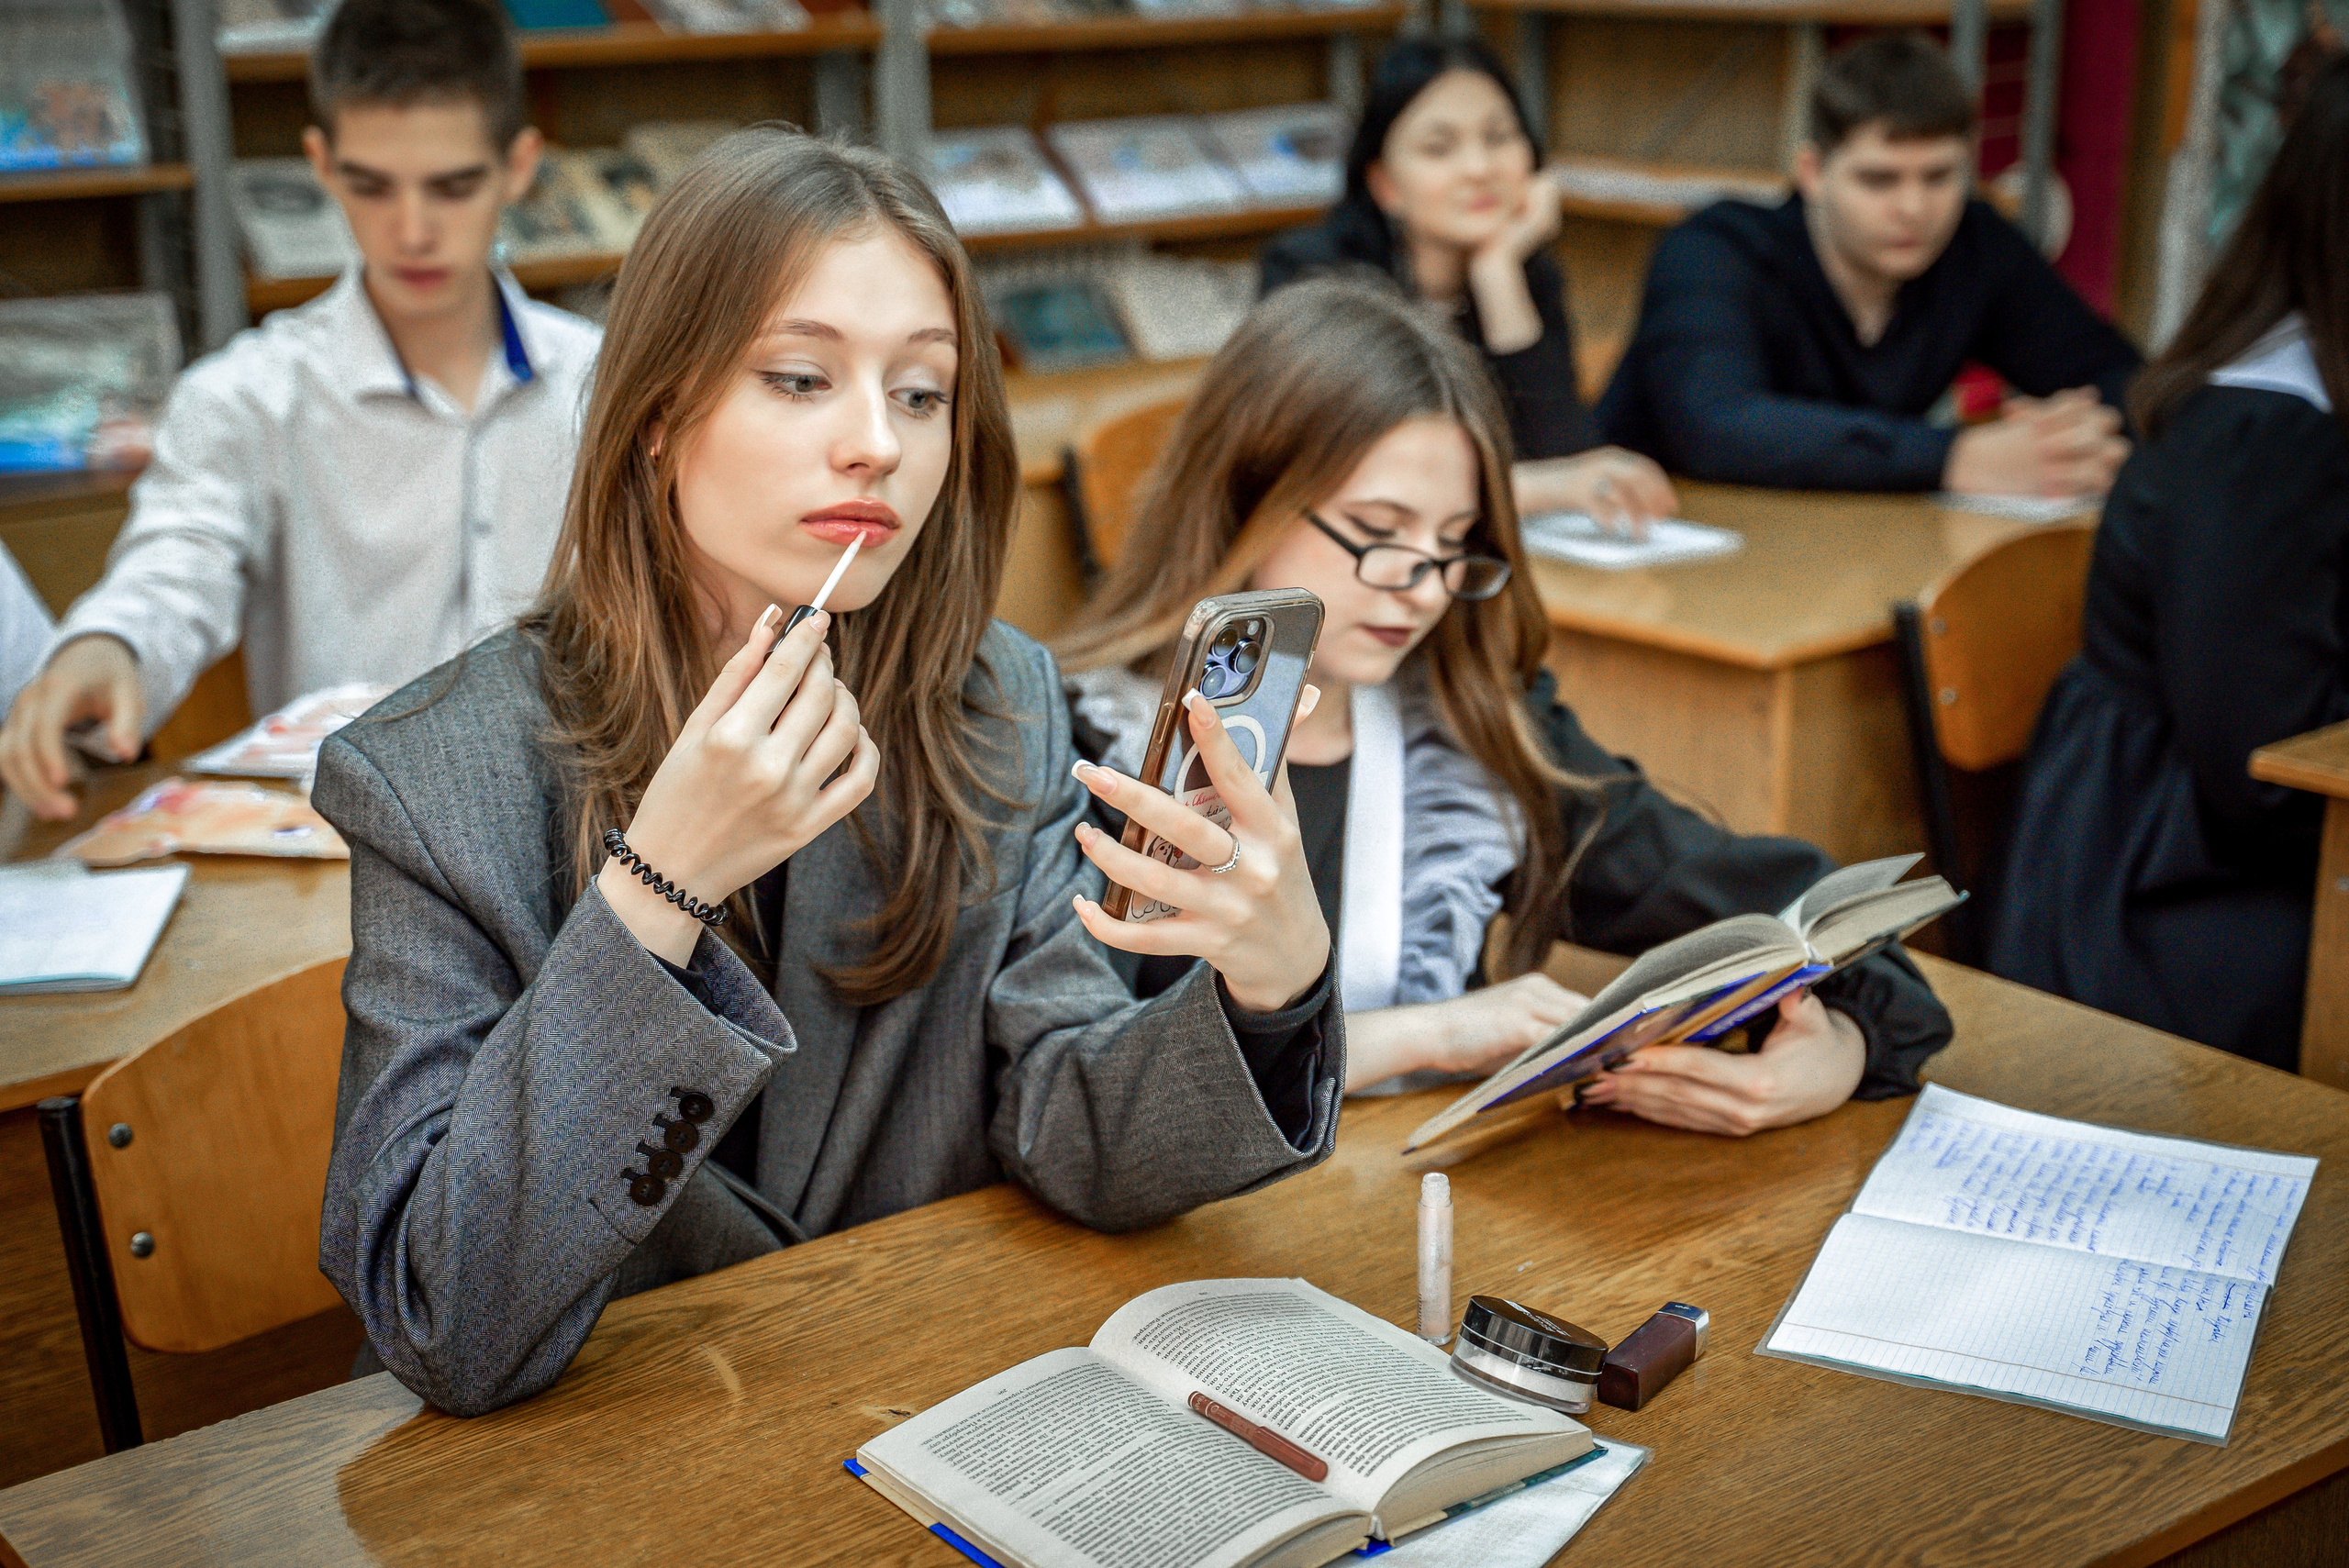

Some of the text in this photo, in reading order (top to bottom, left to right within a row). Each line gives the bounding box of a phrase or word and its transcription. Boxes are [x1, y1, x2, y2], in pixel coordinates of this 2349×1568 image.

[1128, 1316, 1161, 1342] Расстрое-
[1146, 1329, 1174, 1352] поруче-
[1159, 1326, 1191, 1351] грубости
[1166, 1349, 1184, 1364] мел-
[1172, 1341, 1204, 1368] граждан-
[1186, 1346, 1219, 1375] ожидании
[1179, 1354, 1199, 1372] пове-
[1193, 1350, 1229, 1379] положения
[1197, 1353, 1234, 1383] ограничил
[1212, 1371, 1237, 1390] что-то
[1225, 1386, 1242, 1399] Так
[1233, 1393, 1245, 1402] ли
[1238, 1389, 1258, 1407] нему
[1259, 1389, 1270, 1398] не
[1055, 1397, 1075, 1408] совет
[1246, 1396, 1263, 1410] гля-
[1253, 1393, 1278, 1415] как ос-
[1282, 1400, 1293, 1409] не
[968, 1411, 982, 1419] как
[980, 1404, 1008, 1420] полезло
[1003, 1406, 1030, 1422] народу
[1038, 1406, 1056, 1417] даст
[1267, 1407, 1285, 1423] воп-
[1275, 1406, 1297, 1427] может
[994, 1418, 1019, 1433] теперь
[1005, 1419, 1030, 1435] двести
[1282, 1412, 1302, 1431] своих
[940, 1419, 978, 1443] Петербург
[984, 1431, 996, 1440] же
[930, 1433, 964, 1455] закутили
[953, 1435, 975, 1449] славу
[962, 1436, 985, 1451] время
[980, 1432, 1008, 1451] рублей
[971, 1447, 982, 1455] на
